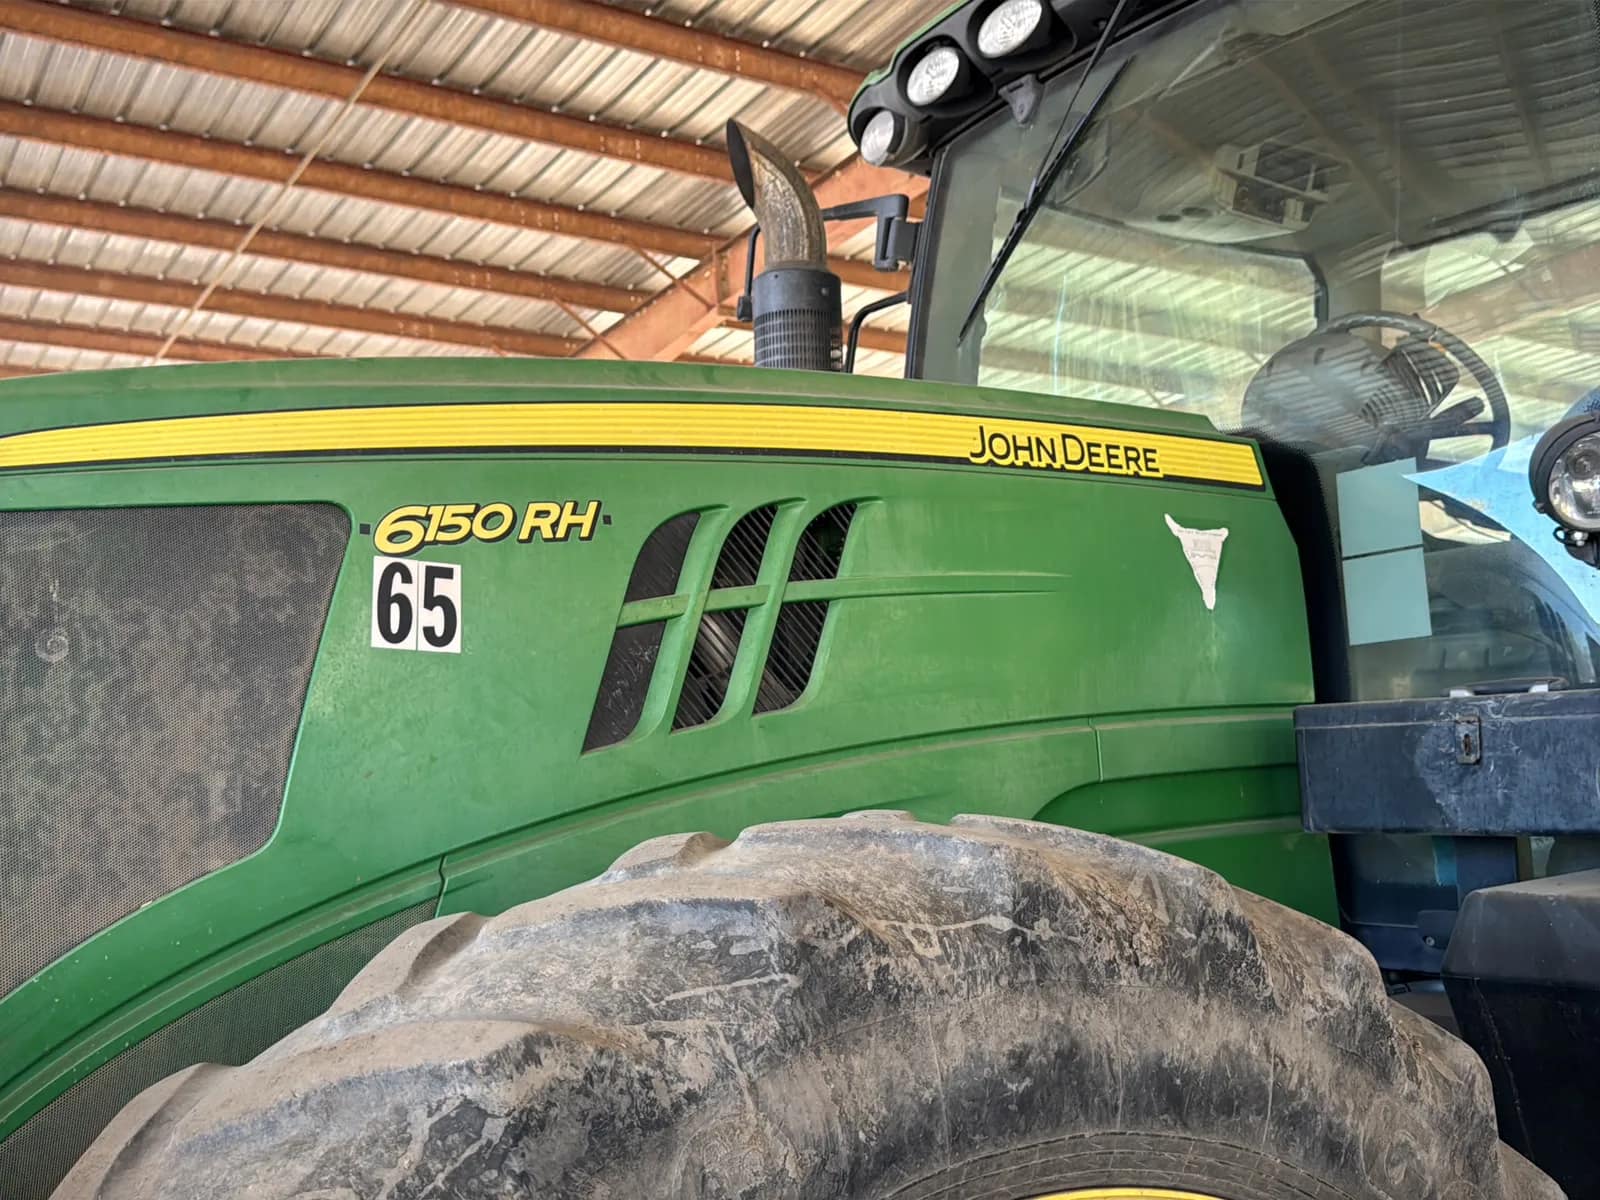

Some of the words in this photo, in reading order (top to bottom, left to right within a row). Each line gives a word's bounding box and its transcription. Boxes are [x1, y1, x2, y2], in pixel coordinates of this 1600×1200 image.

[969, 425, 1058, 466] JOHN
[1061, 433, 1162, 475] DEERE
[373, 502, 518, 557] 6150
[517, 500, 601, 543] RH
[377, 561, 457, 647] 65
